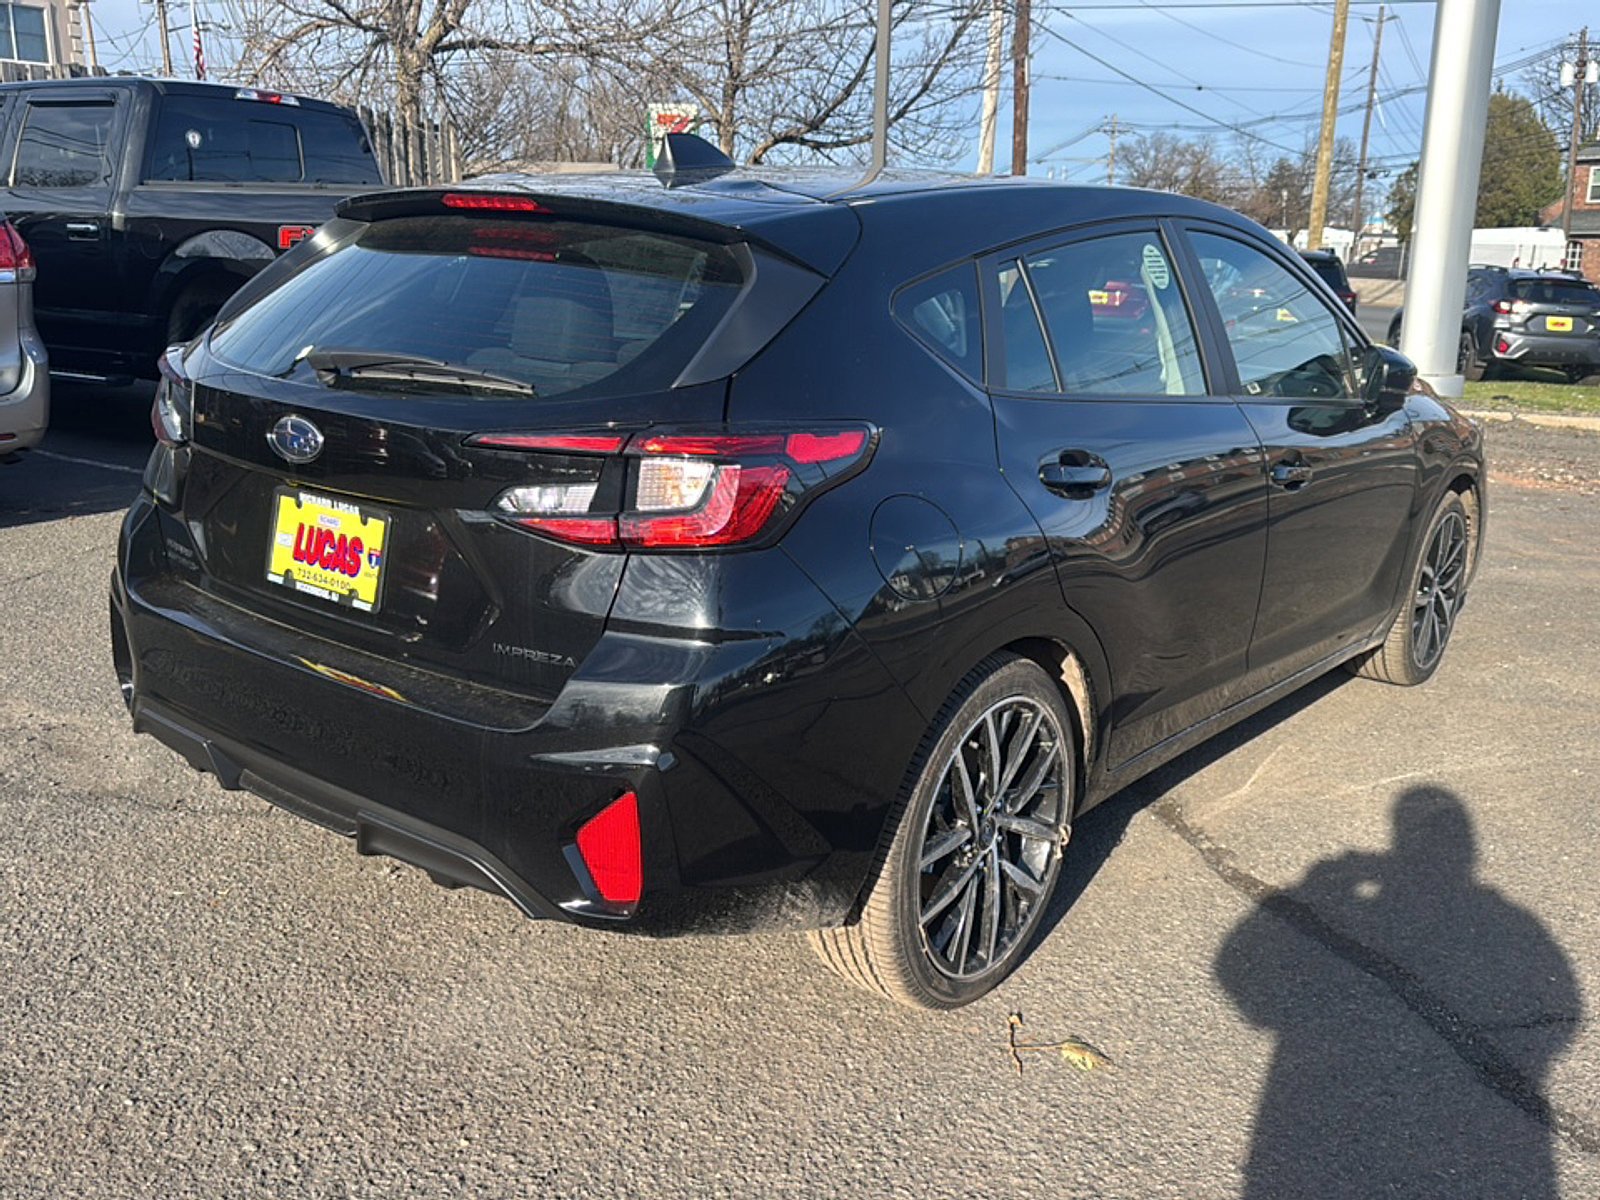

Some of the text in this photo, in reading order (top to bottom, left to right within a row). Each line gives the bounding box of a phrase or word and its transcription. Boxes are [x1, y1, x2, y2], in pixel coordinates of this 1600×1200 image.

[293, 522, 364, 578] LUCAS
[297, 568, 351, 590] 732-634-0100
[493, 642, 576, 668] IMPREZA
